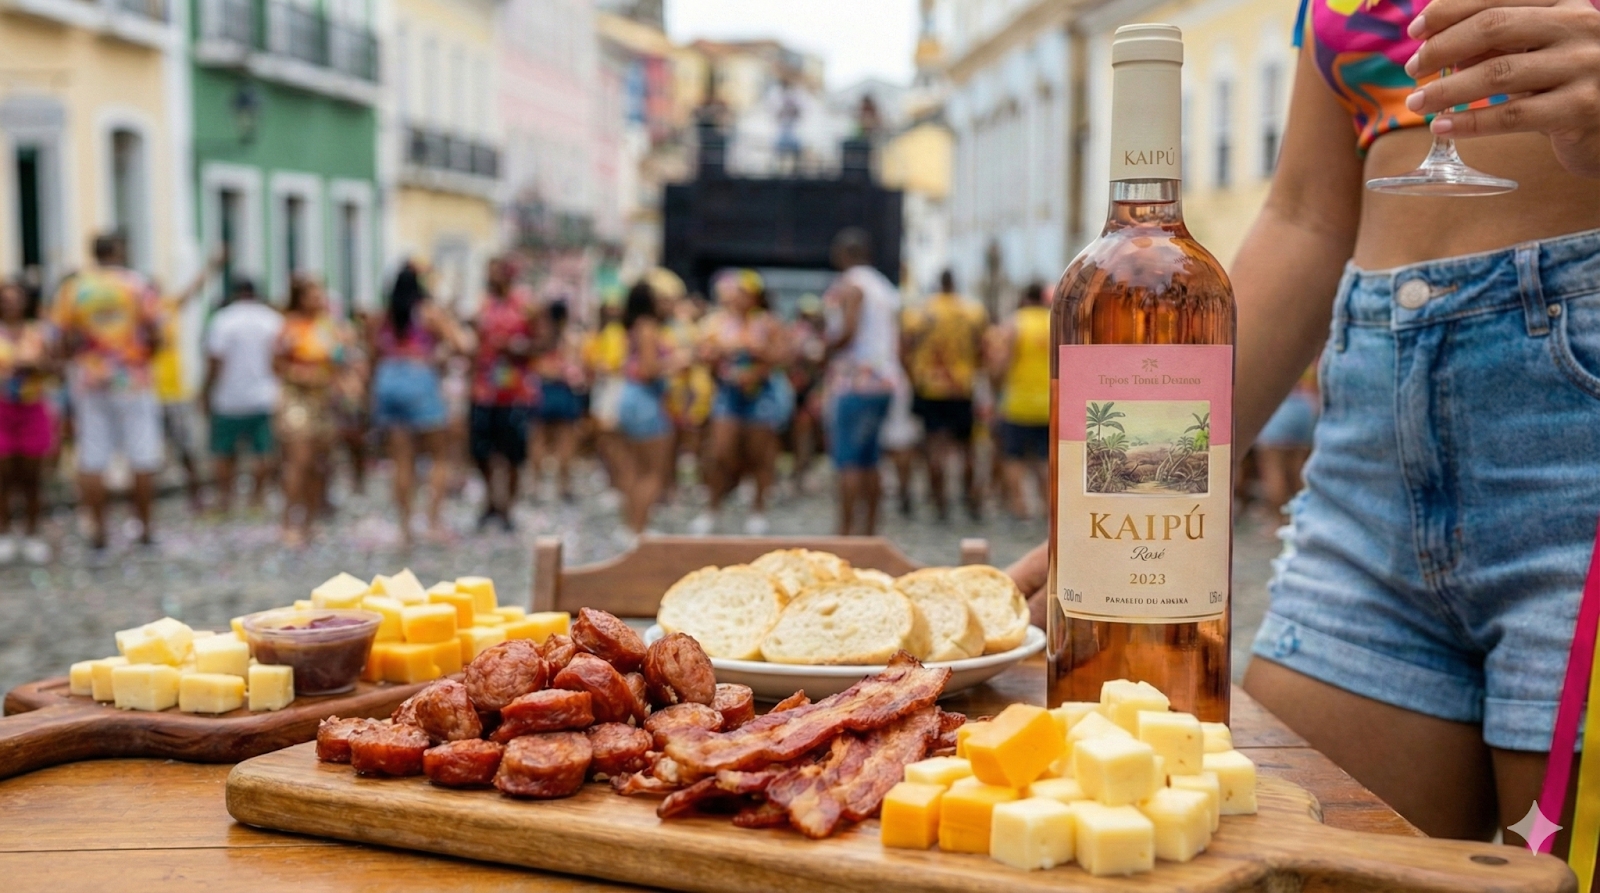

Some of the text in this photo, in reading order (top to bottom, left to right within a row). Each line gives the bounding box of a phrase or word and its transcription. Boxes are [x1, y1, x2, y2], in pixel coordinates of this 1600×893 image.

[1124, 147, 1175, 166] KAIPÚ
[1089, 504, 1206, 541] KAIPÚ
[1130, 545, 1166, 561] Rosé
[1129, 573, 1167, 585] 2023
